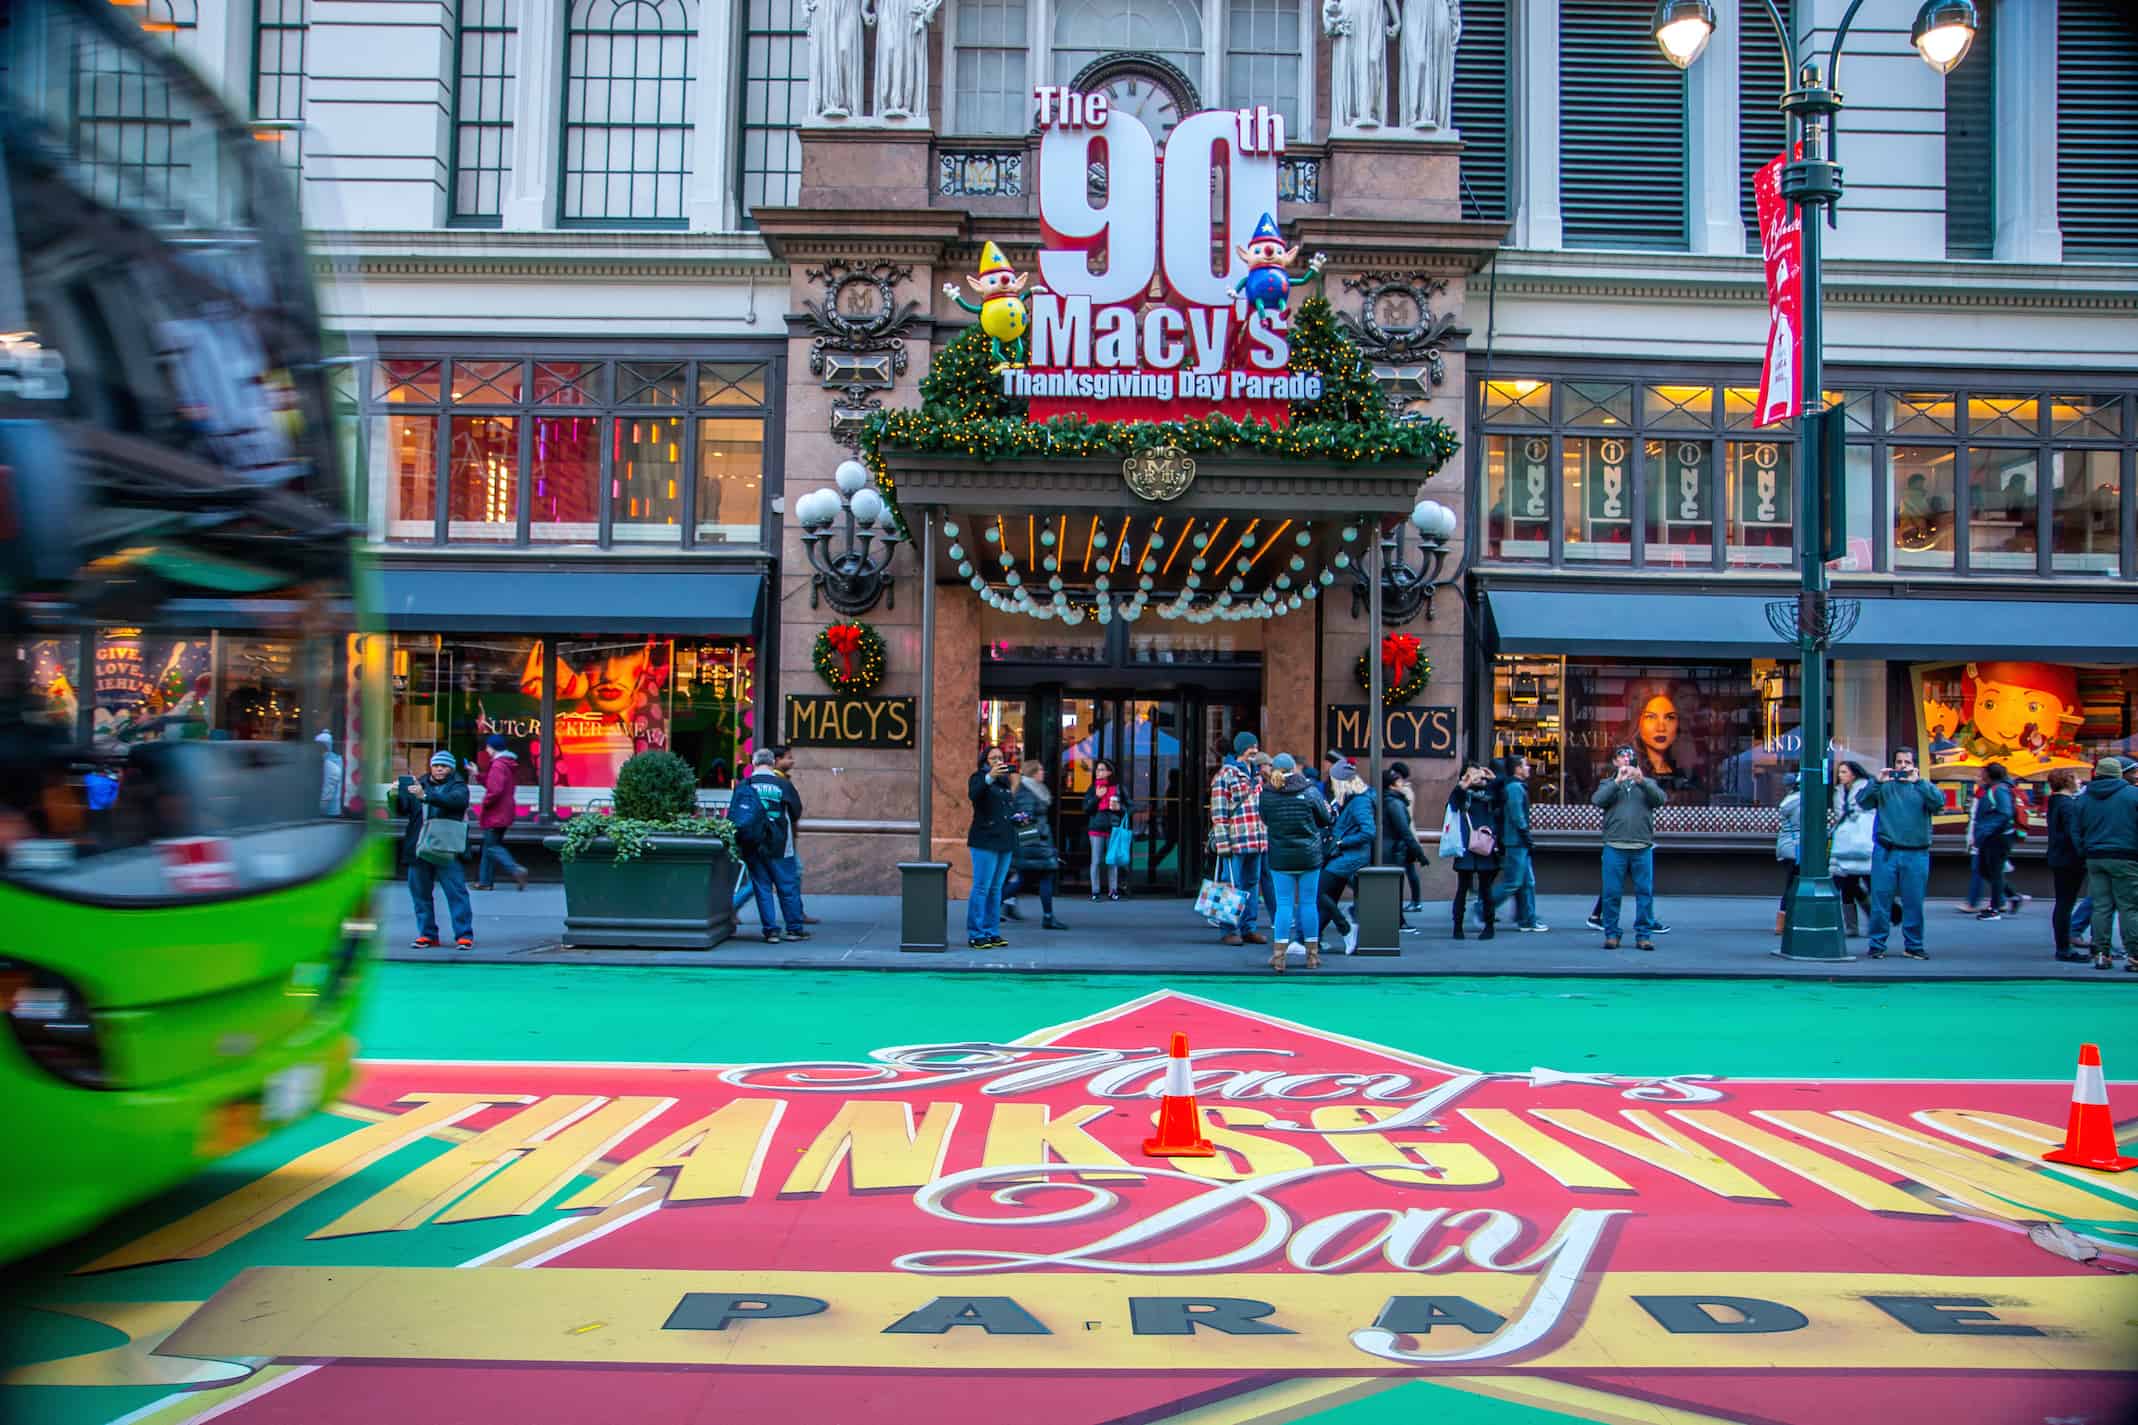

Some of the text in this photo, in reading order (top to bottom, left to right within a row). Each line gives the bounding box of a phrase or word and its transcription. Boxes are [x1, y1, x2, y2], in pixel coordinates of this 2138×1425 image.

[1034, 86, 1108, 131] The
[1030, 293, 1291, 374] Macy's
[1001, 369, 1323, 401] Thanksgiving Day Parade
[484, 718, 601, 738] NUTCRCKER
[792, 700, 909, 740] MACY'S
[891, 1162, 1632, 1364] Day
[661, 1291, 2048, 1338] PARADE
